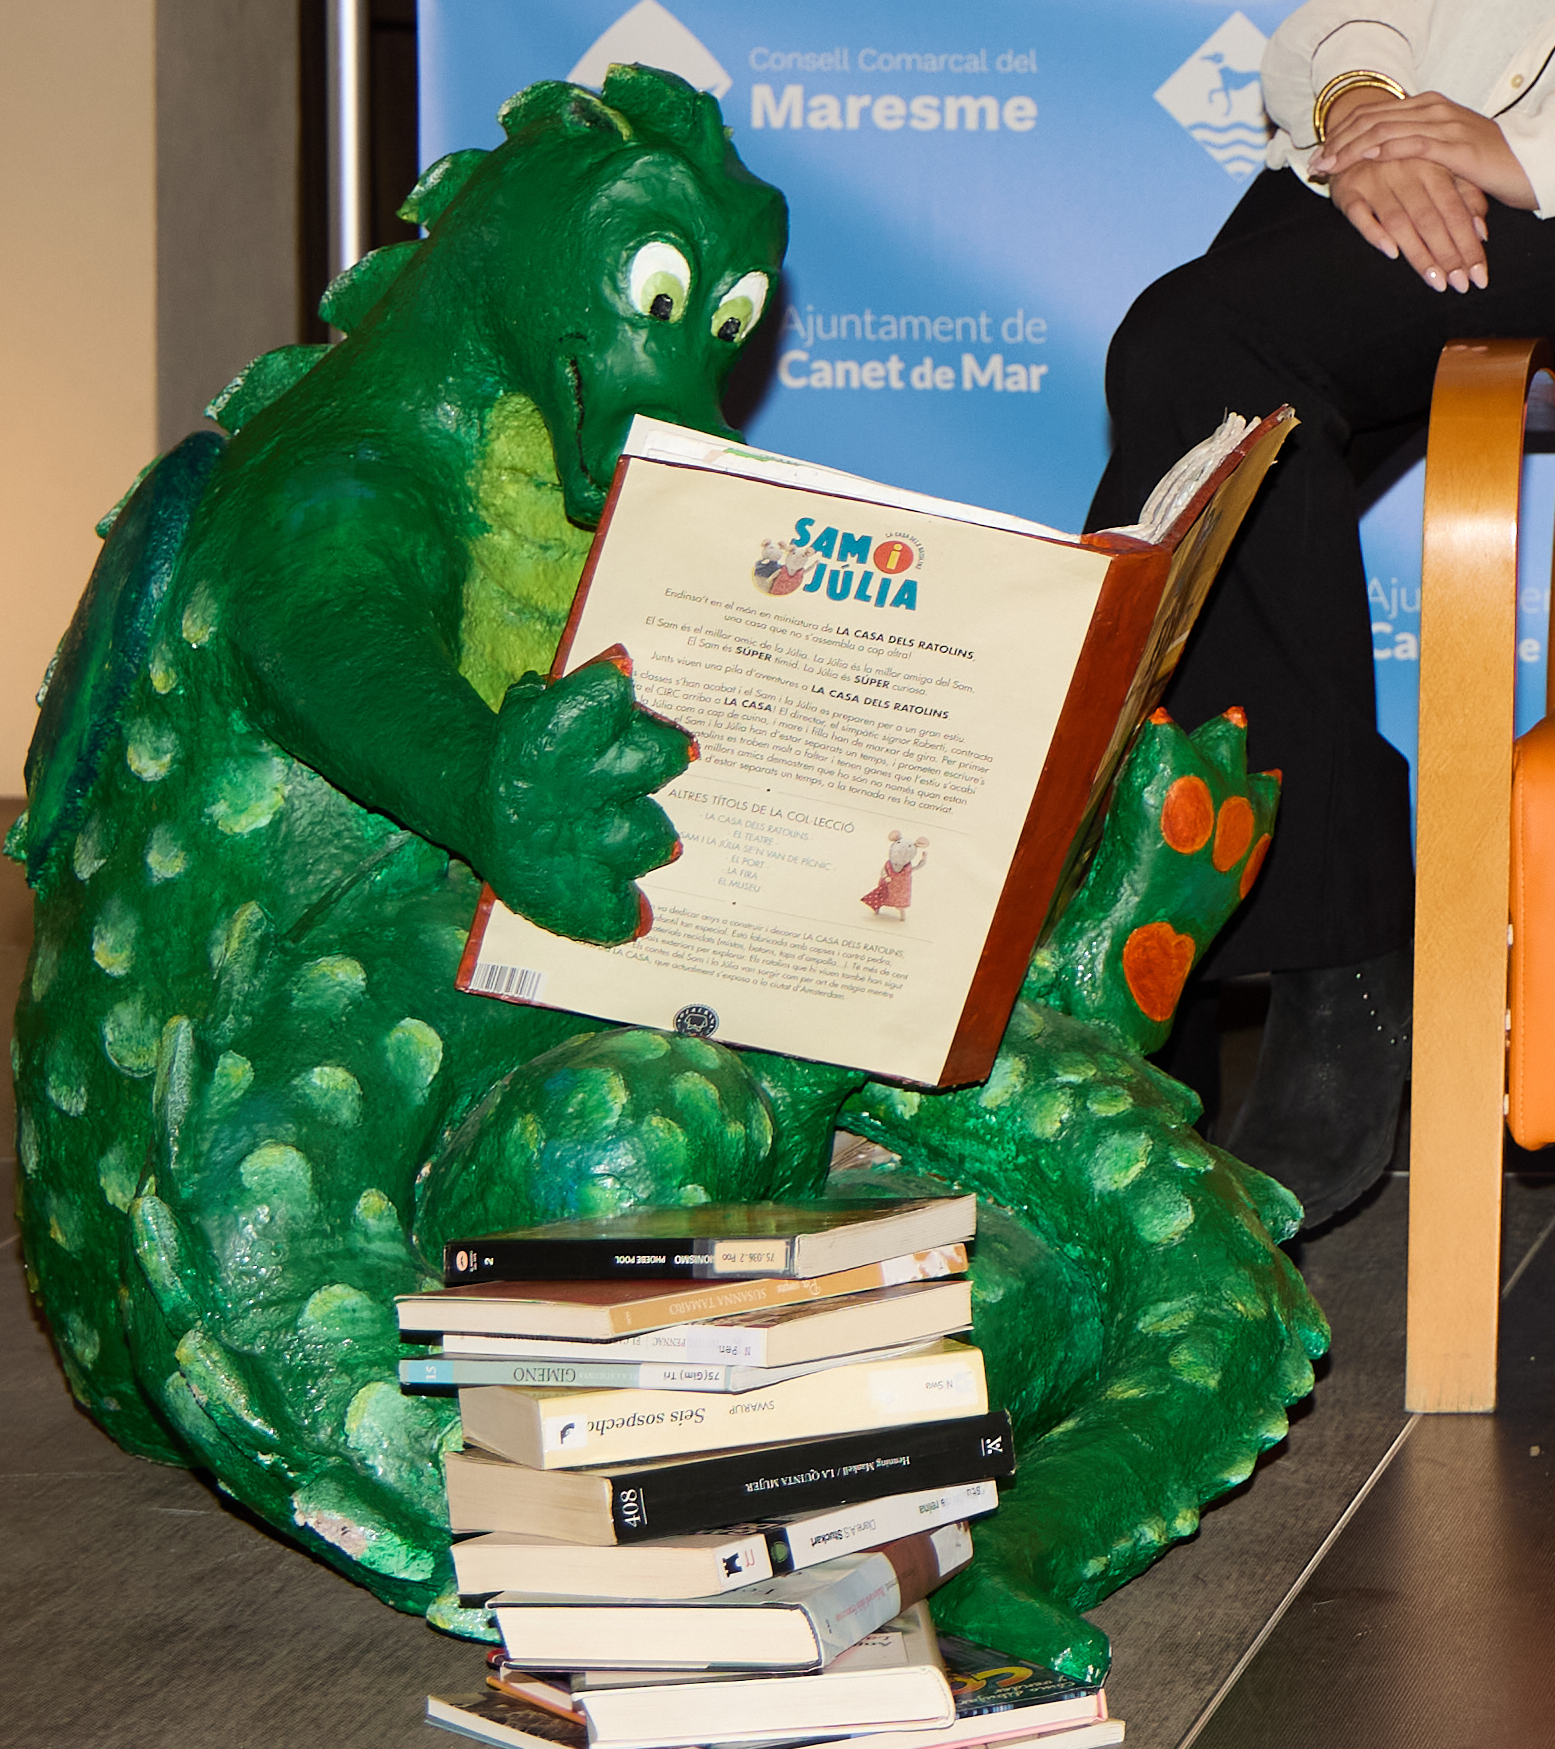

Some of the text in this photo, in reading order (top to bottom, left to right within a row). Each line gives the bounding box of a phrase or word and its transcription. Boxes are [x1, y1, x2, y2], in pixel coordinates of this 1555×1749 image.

[748, 46, 1039, 76] Consell Comarcal del
[750, 83, 1039, 132] Maresme
[782, 303, 1049, 348] Ajuntament de
[778, 349, 1050, 393] Canet de Mar
[789, 517, 903, 570] SAM i
[803, 559, 919, 612] JÚLIA
[664, 587, 977, 663] Endinsa't en el món en miniatura de LA CASA DELS RATOLINS,
[724, 613, 743, 625] una
[744, 618, 767, 630] casa
[769, 624, 788, 636] que
[790, 629, 802, 639] no
[804, 632, 856, 651] s'assembla
[867, 645, 885, 657] cap
[887, 647, 912, 660] altra!
[645, 615, 975, 694] El Sam és el millor amic de la Júlia. La Júlia és la millor amiga del Sam.
[668, 788, 709, 804] ALTRES
[712, 794, 749, 811] TÍTOLS
[751, 802, 767, 815] DE
[769, 806, 783, 819] LA
[614, 1254, 667, 1265] PHOEBE POOL
[668, 1286, 768, 1316] SUSANNA TAMARO
[651, 1336, 686, 1348] PENNAC
[717, 1344, 738, 1356] Pen
[513, 1367, 577, 1382] GIMENO
[663, 1370, 676, 1381] Tri
[671, 1406, 706, 1426] Seis
[728, 1399, 776, 1415] SWARUP
[821, 1465, 836, 1480] LA
[874, 1454, 912, 1470] Henning
[744, 1474, 780, 1493] MUJER
[780, 1469, 822, 1486] QUINTA
[620, 1488, 642, 1528] 408
